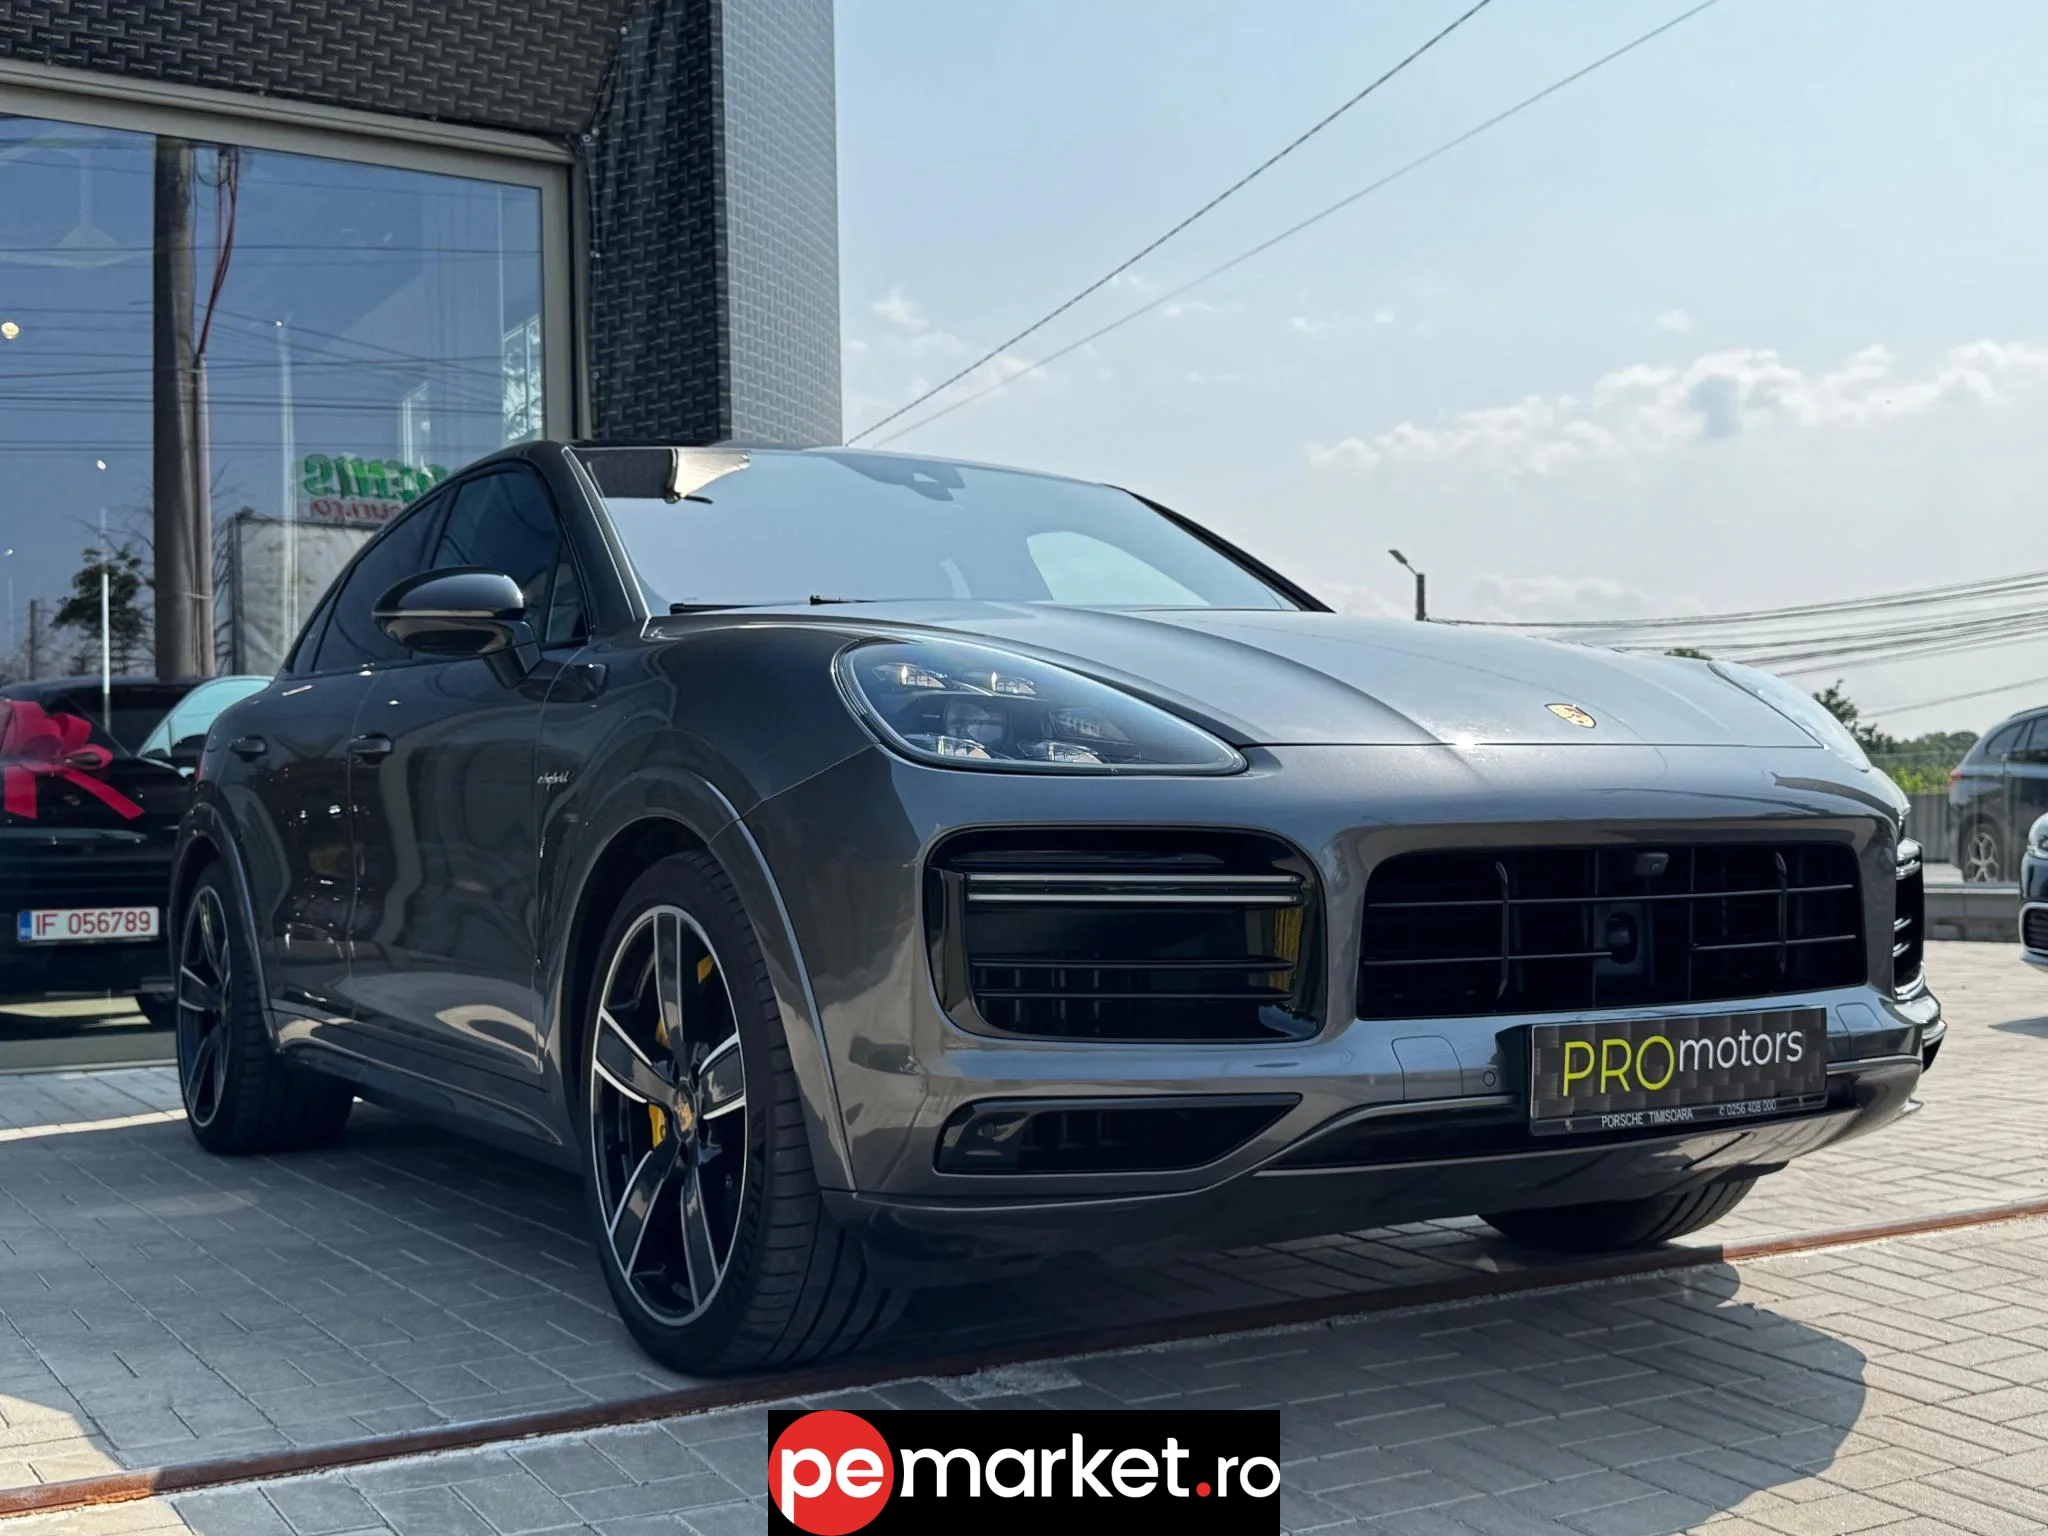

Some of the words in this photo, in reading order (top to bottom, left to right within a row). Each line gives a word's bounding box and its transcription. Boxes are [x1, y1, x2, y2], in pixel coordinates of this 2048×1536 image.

[36, 913, 58, 936] IF
[68, 911, 151, 935] 056789
[1601, 1112, 1644, 1128] PORSCHE
[1649, 1107, 1694, 1124] TIMISOARA
[1726, 1102, 1746, 1116] 0256
[1762, 1099, 1777, 1112] 000
